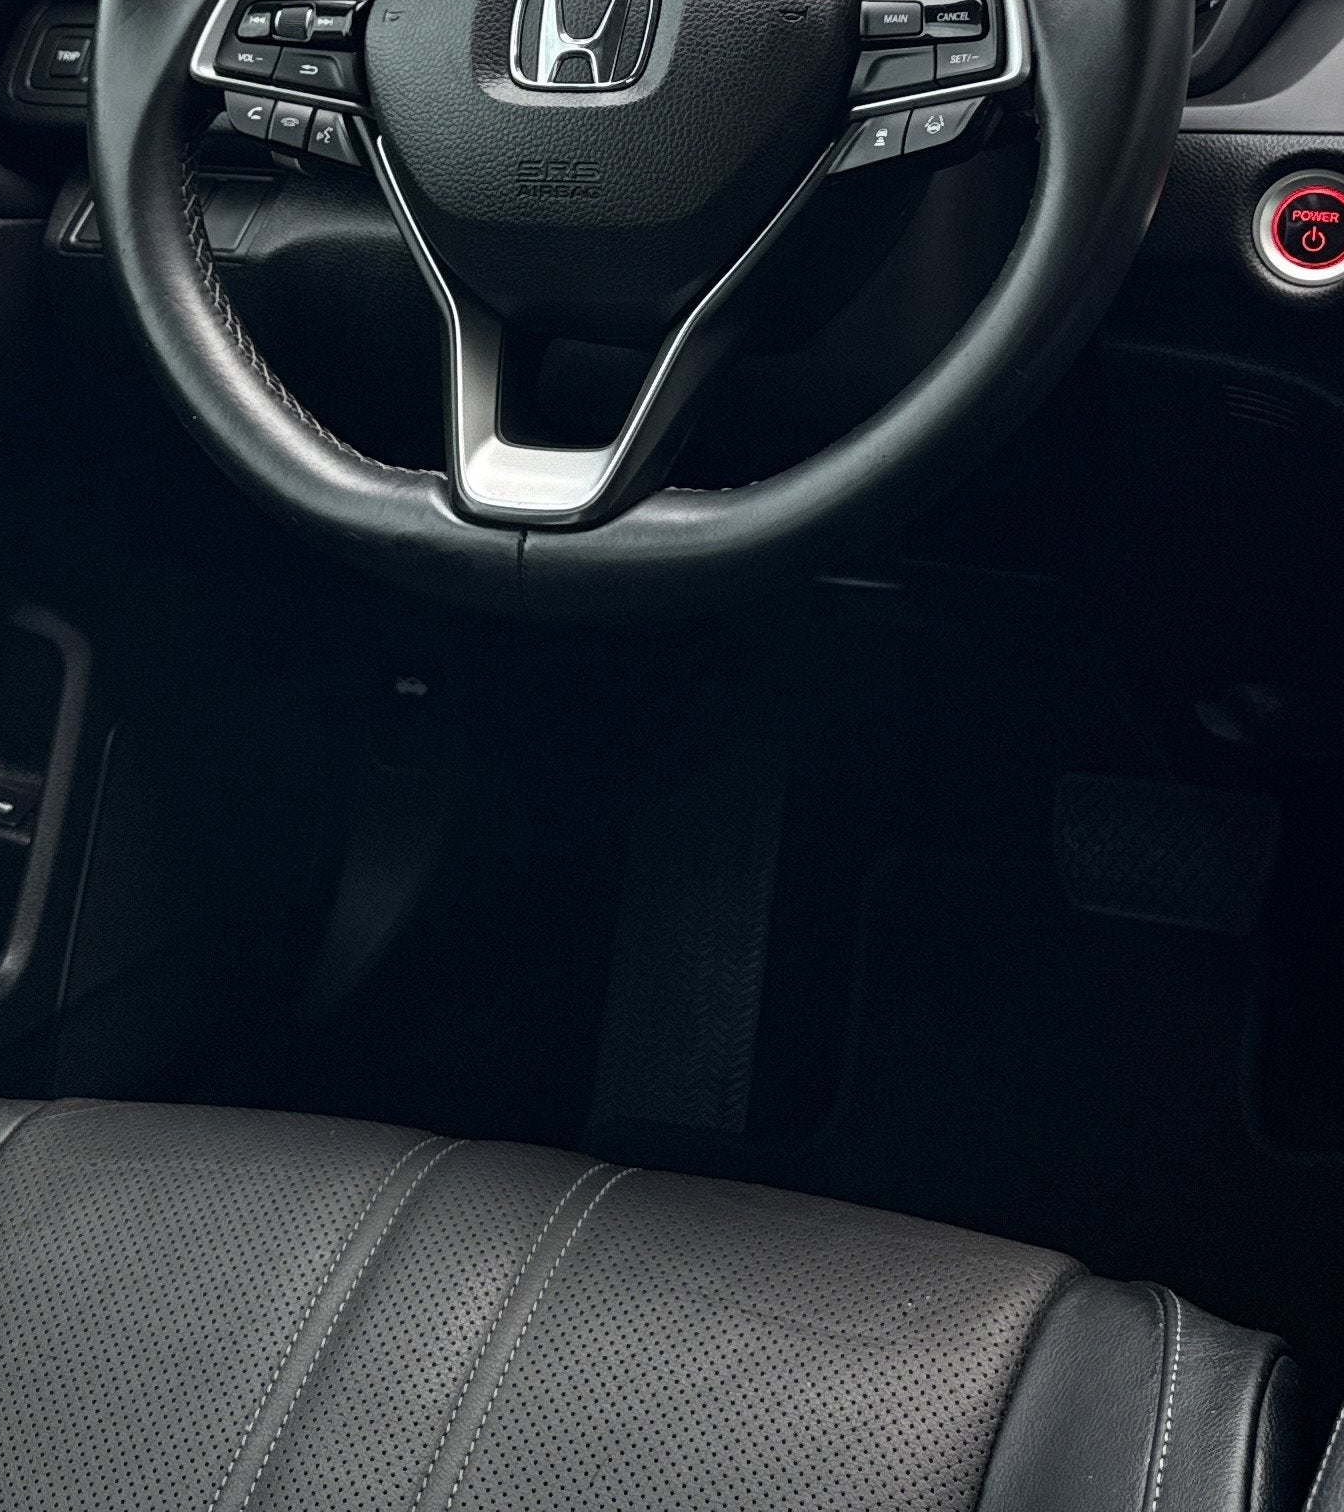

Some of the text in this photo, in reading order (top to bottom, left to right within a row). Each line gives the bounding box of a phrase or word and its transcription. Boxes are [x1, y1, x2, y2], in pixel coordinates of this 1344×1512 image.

[884, 14, 908, 24] MAIN
[936, 12, 970, 22] CANCEL
[56, 50, 81, 61] TRIP
[516, 160, 601, 183] SRS
[1292, 210, 1340, 224] POWER
